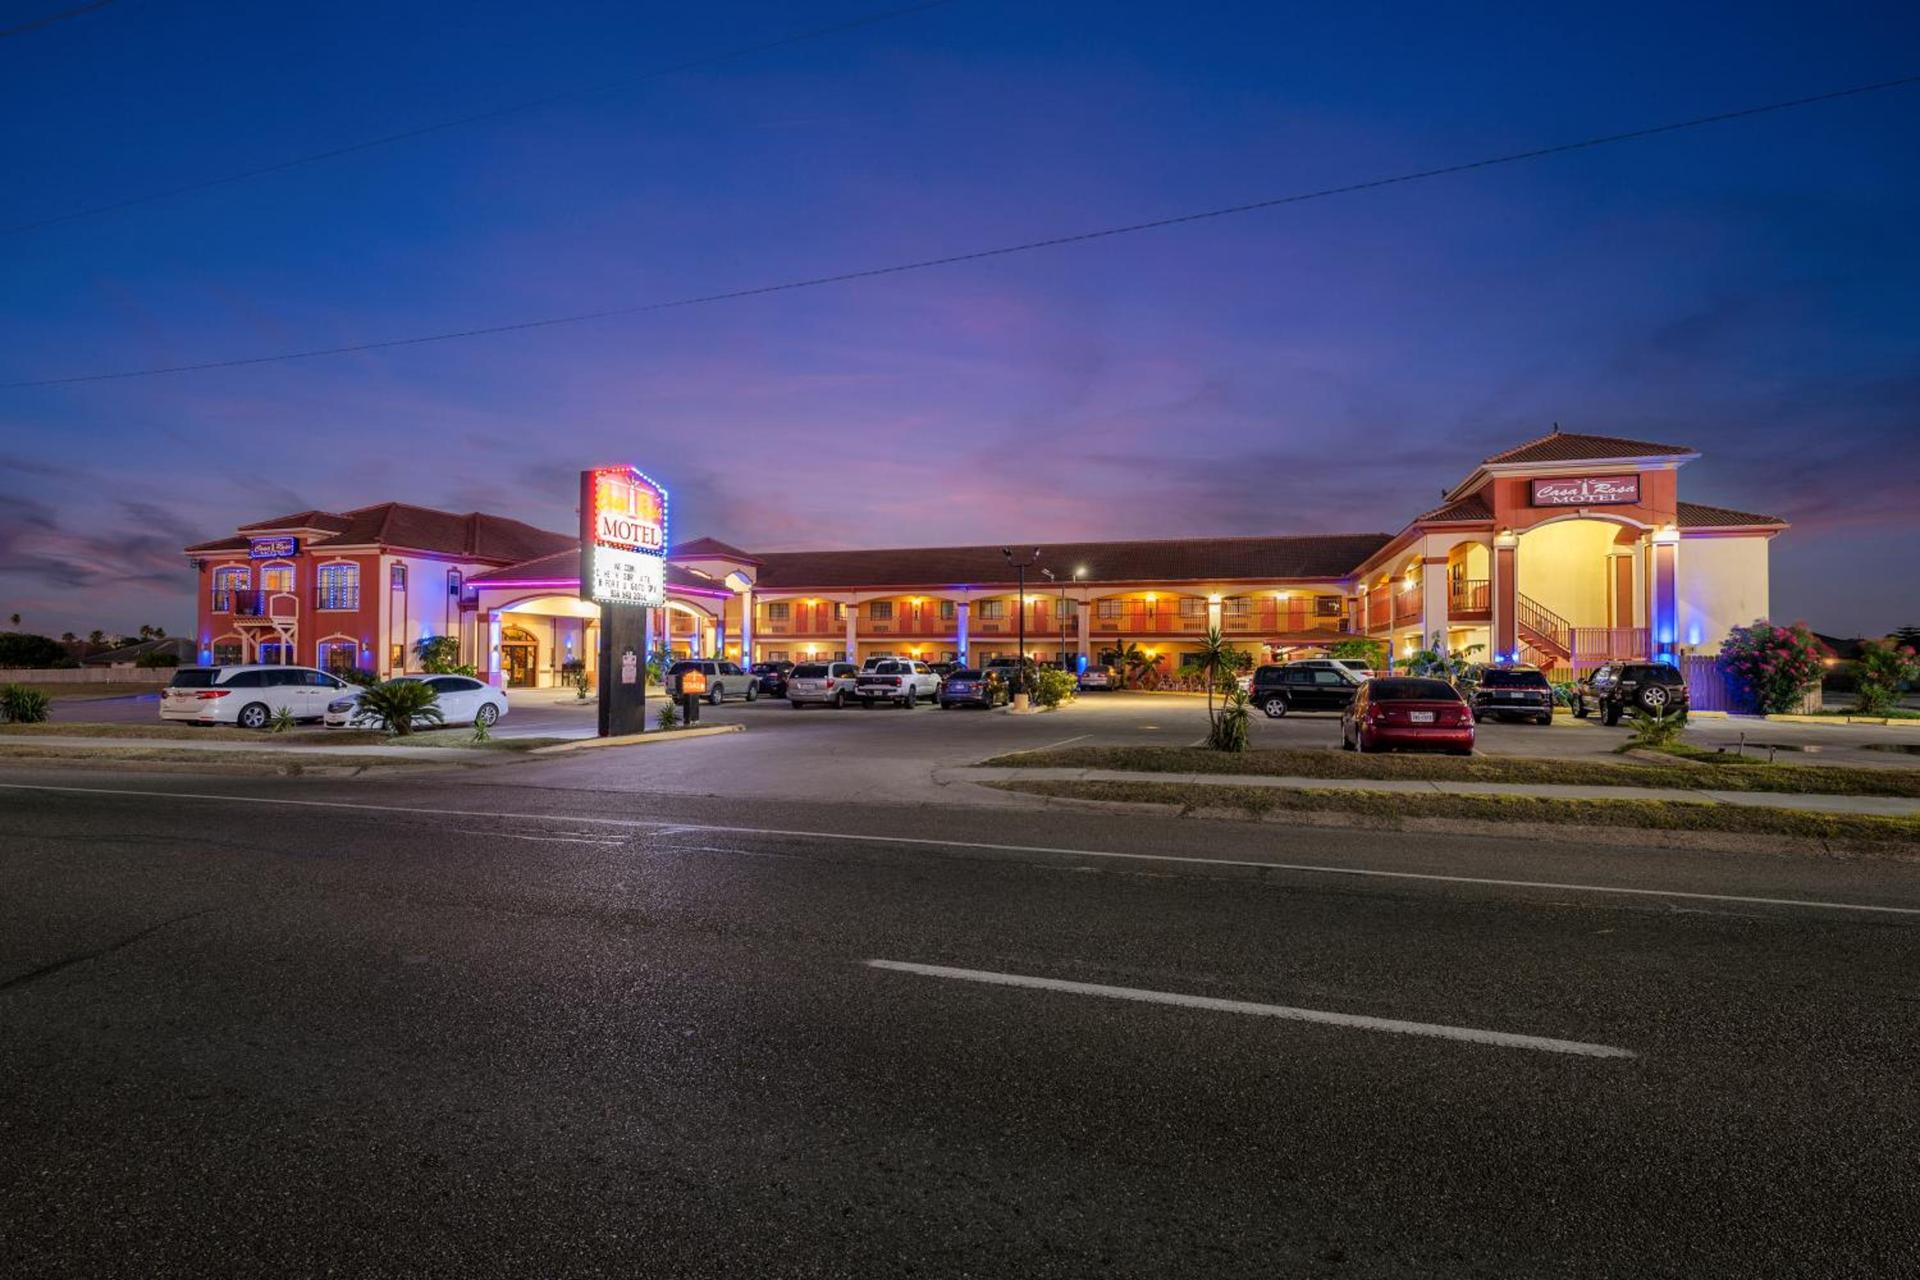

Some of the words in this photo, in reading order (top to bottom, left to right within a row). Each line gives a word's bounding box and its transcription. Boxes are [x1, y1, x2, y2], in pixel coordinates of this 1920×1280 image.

[1536, 485, 1578, 498] Casa
[1593, 483, 1635, 494] Rosa
[1551, 494, 1622, 503] MOTEL
[603, 516, 660, 545] MOTEL
